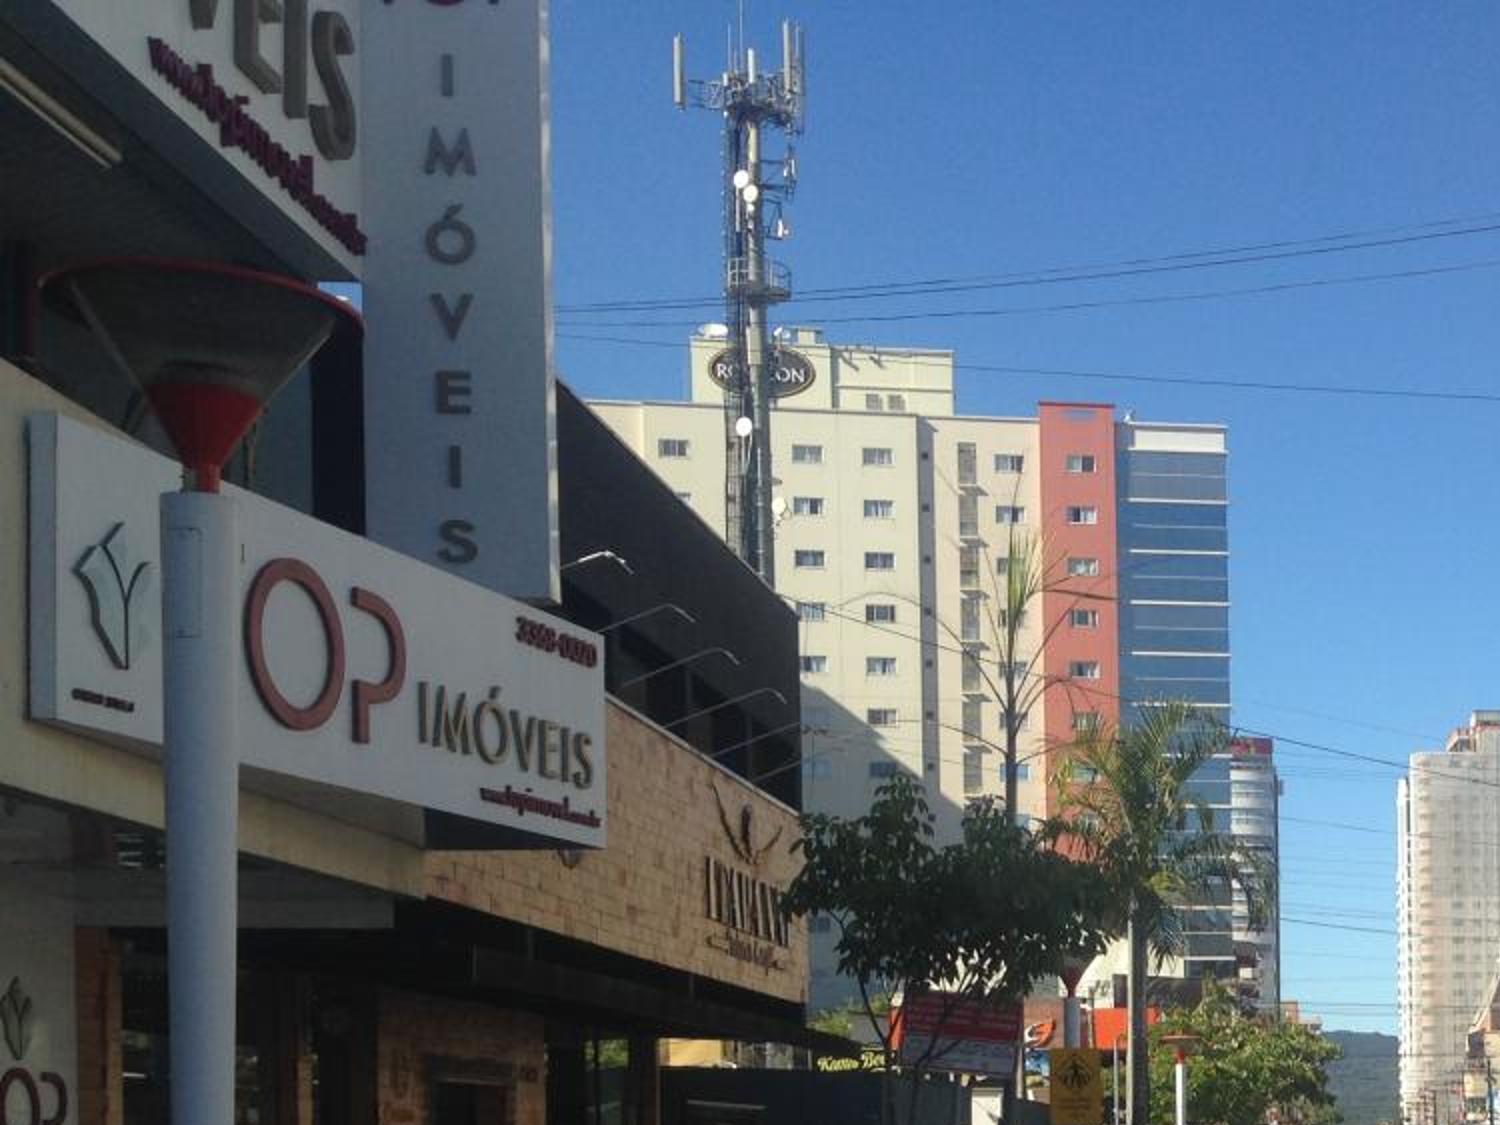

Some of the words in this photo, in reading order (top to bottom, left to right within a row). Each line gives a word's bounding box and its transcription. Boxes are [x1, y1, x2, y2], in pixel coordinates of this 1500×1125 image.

[190, 0, 358, 160] EIS
[424, 53, 480, 564] IMÓVEIS
[242, 557, 407, 744] OP
[418, 681, 592, 789] IMÓVEIS
